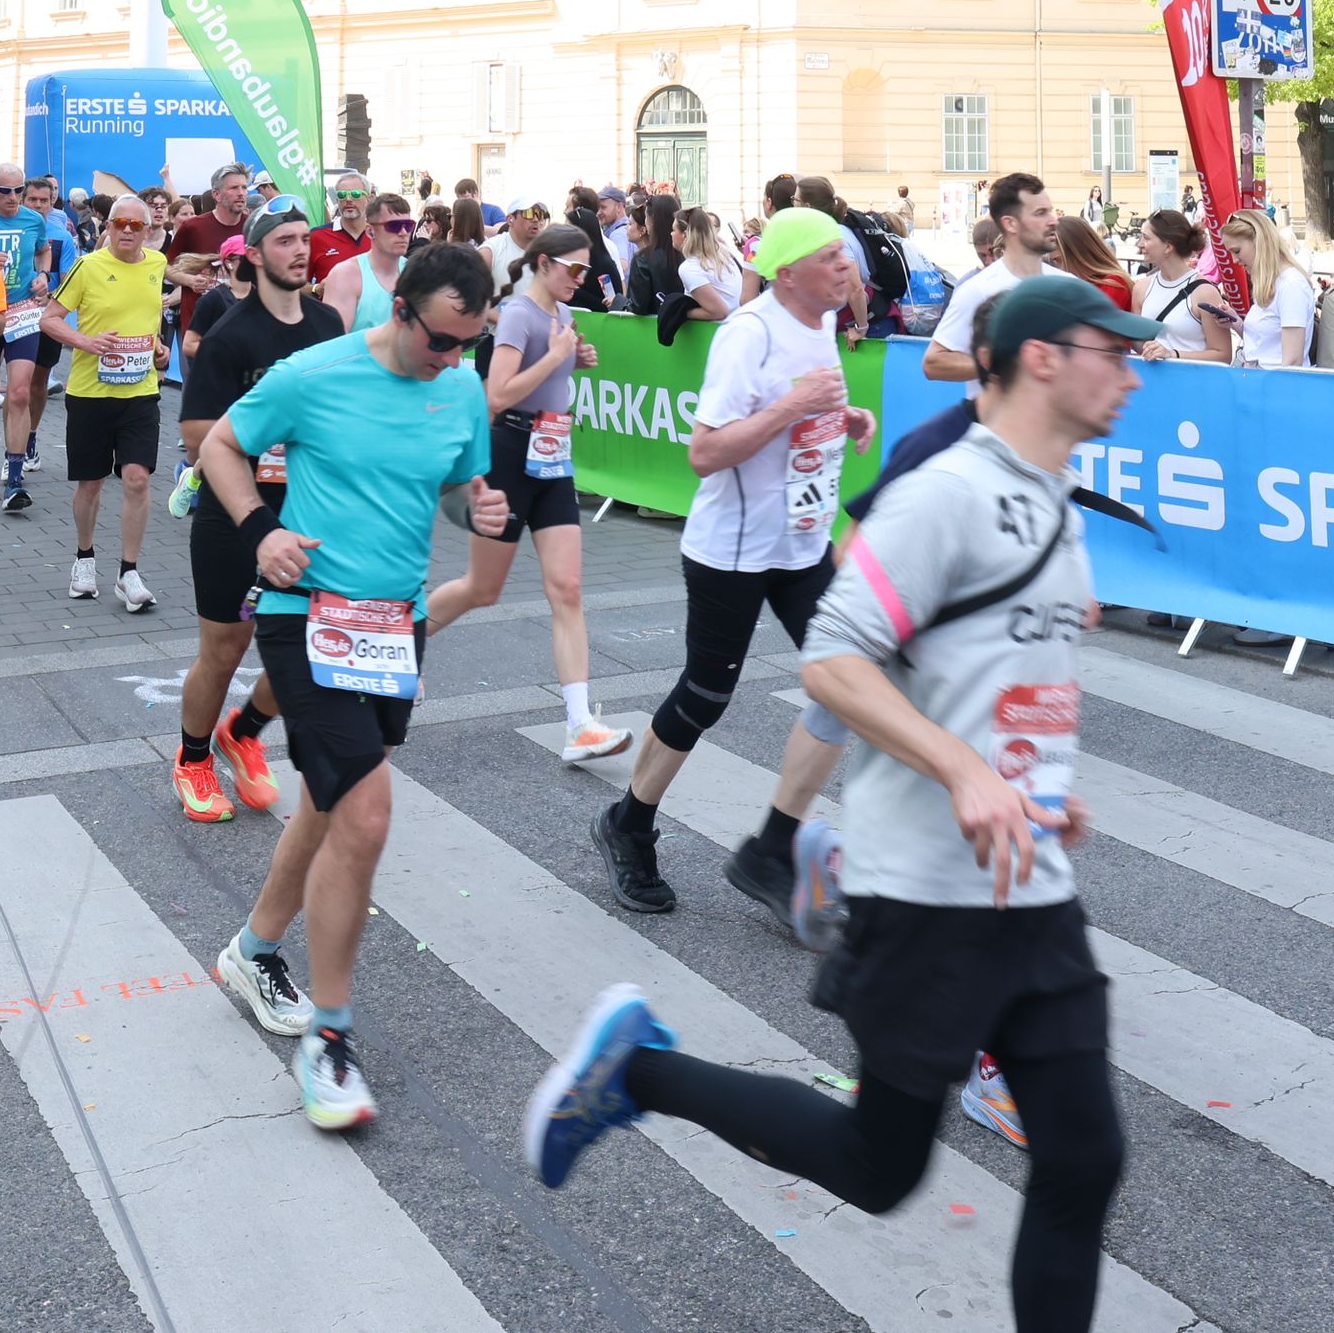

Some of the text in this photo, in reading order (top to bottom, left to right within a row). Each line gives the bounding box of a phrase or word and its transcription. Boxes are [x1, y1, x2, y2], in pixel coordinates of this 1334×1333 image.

[66, 98, 125, 115] ERSTE
[154, 99, 231, 116] SPARKA
[66, 117, 145, 137] Running
[19, 311, 41, 322] Günter
[126, 355, 151, 367] Peter
[354, 638, 408, 661] Goran
[332, 672, 382, 693] ERSTE
